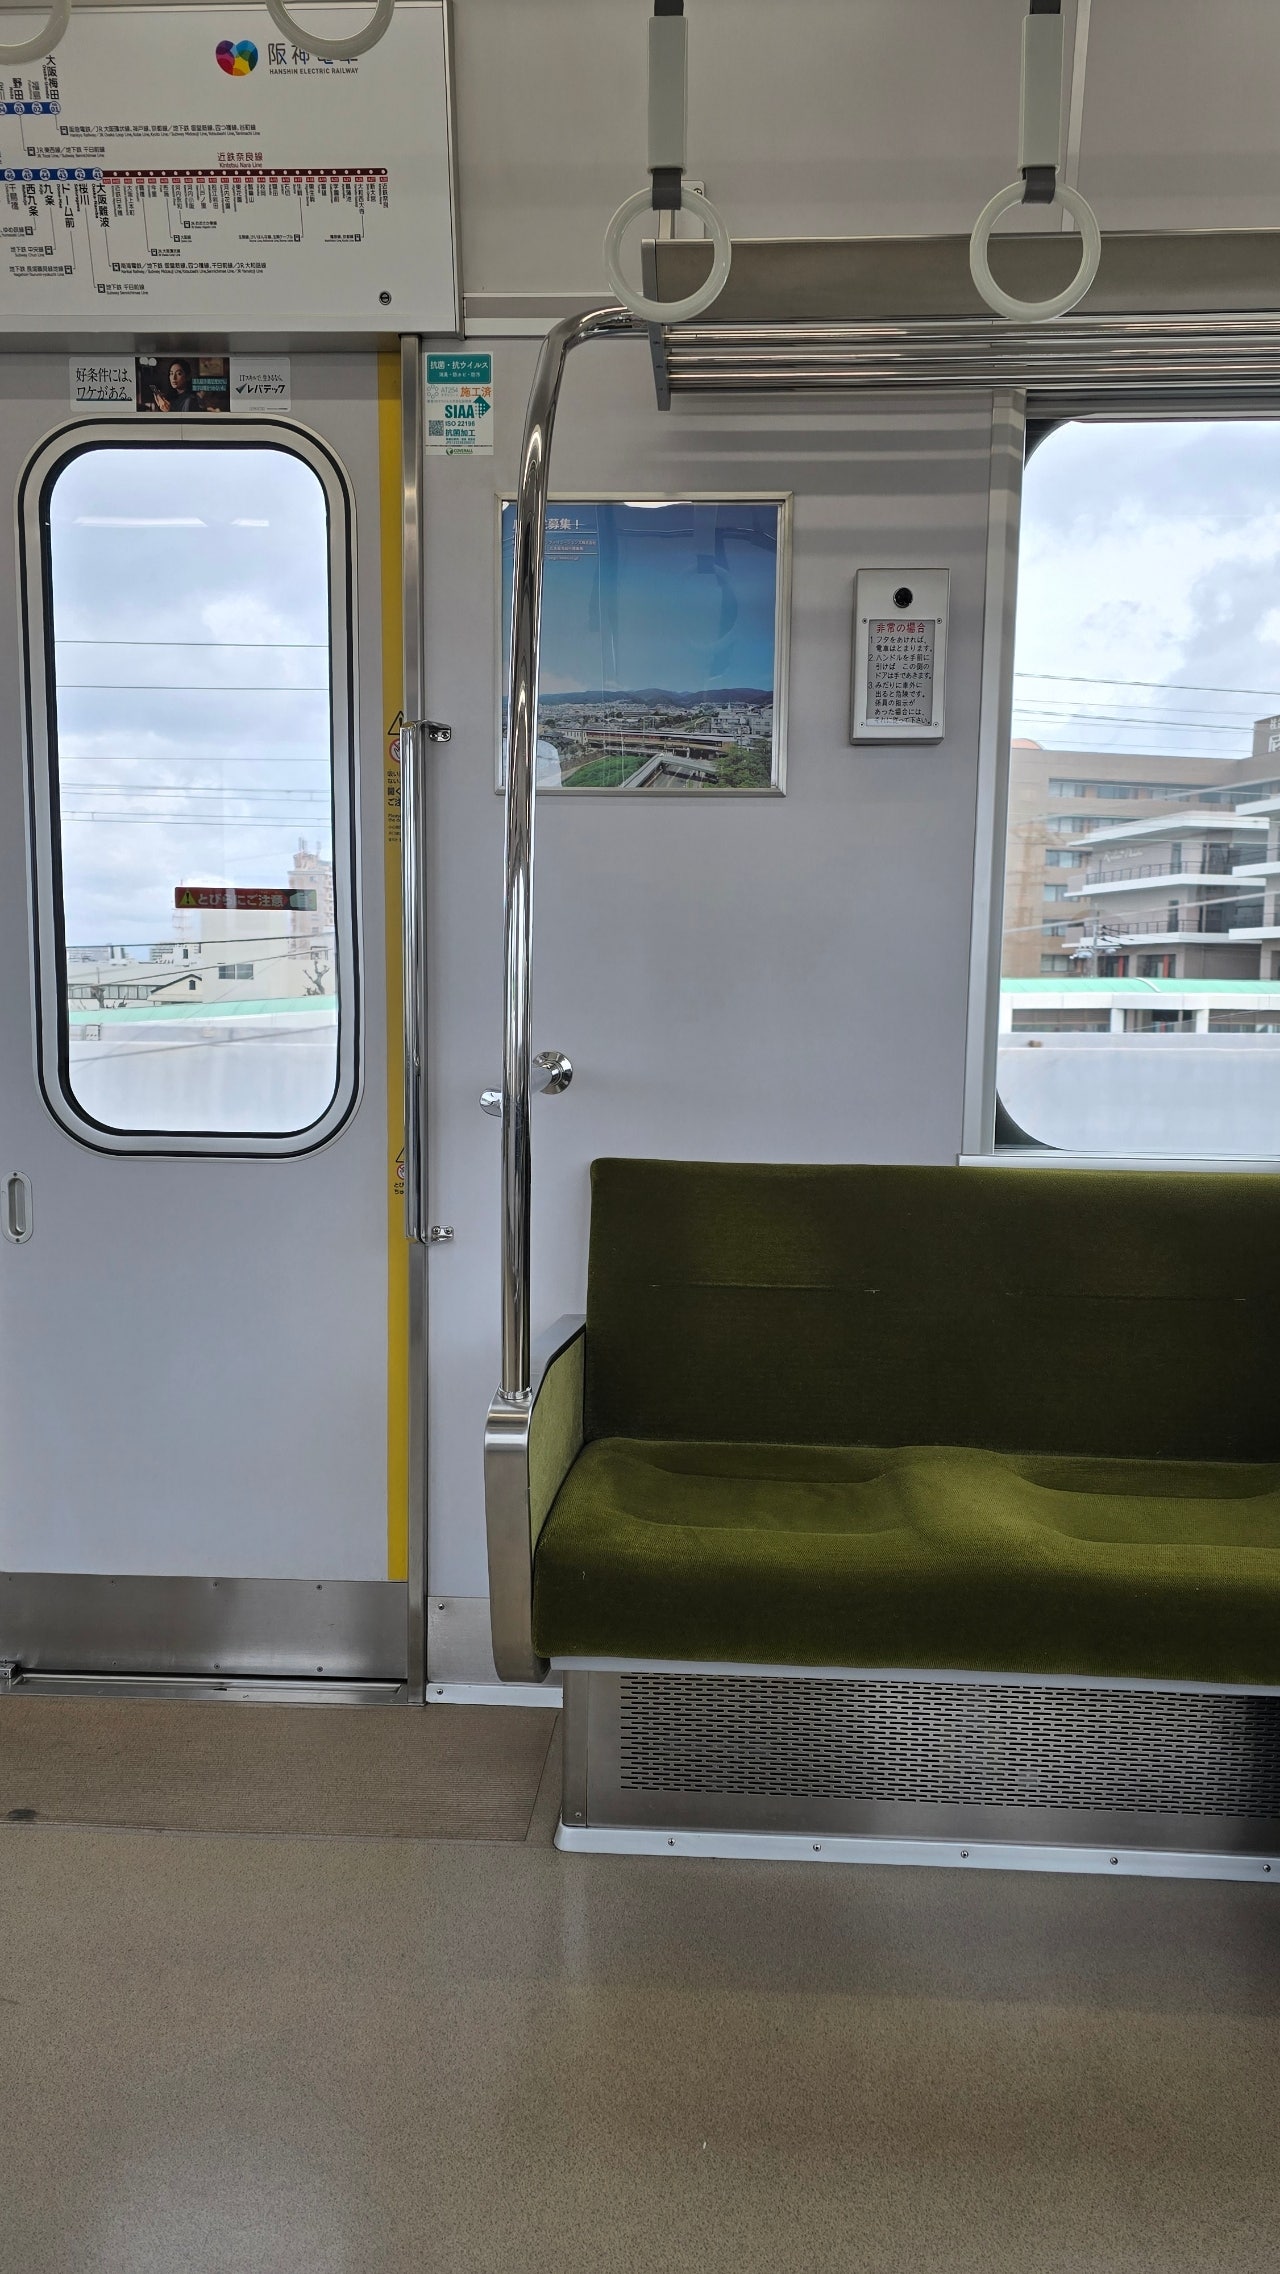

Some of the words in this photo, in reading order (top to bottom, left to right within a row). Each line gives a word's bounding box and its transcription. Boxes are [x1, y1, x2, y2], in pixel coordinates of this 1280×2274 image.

[268, 43, 358, 65] 阪神
[46, 55, 59, 100] 大阪梅田
[12, 77, 24, 100] 野田
[217, 152, 263, 161] 近鉄奈良線
[26, 184, 38, 217] 西九条
[44, 184, 55, 205] 九条
[79, 183, 90, 205] 桜川
[62, 184, 74, 228] ドーム前
[96, 183, 110, 228] 大阪難波
[430, 361, 488, 370] 抗菌・抗ウイルス
[76, 368, 132, 382] 好条件には、
[77, 385, 132, 400] ワケがある。
[247, 384, 286, 394] レバテック
[460, 386, 491, 397] 施工済
[445, 405, 474, 418] SIAA
[876, 622, 925, 633] 非常の場合
